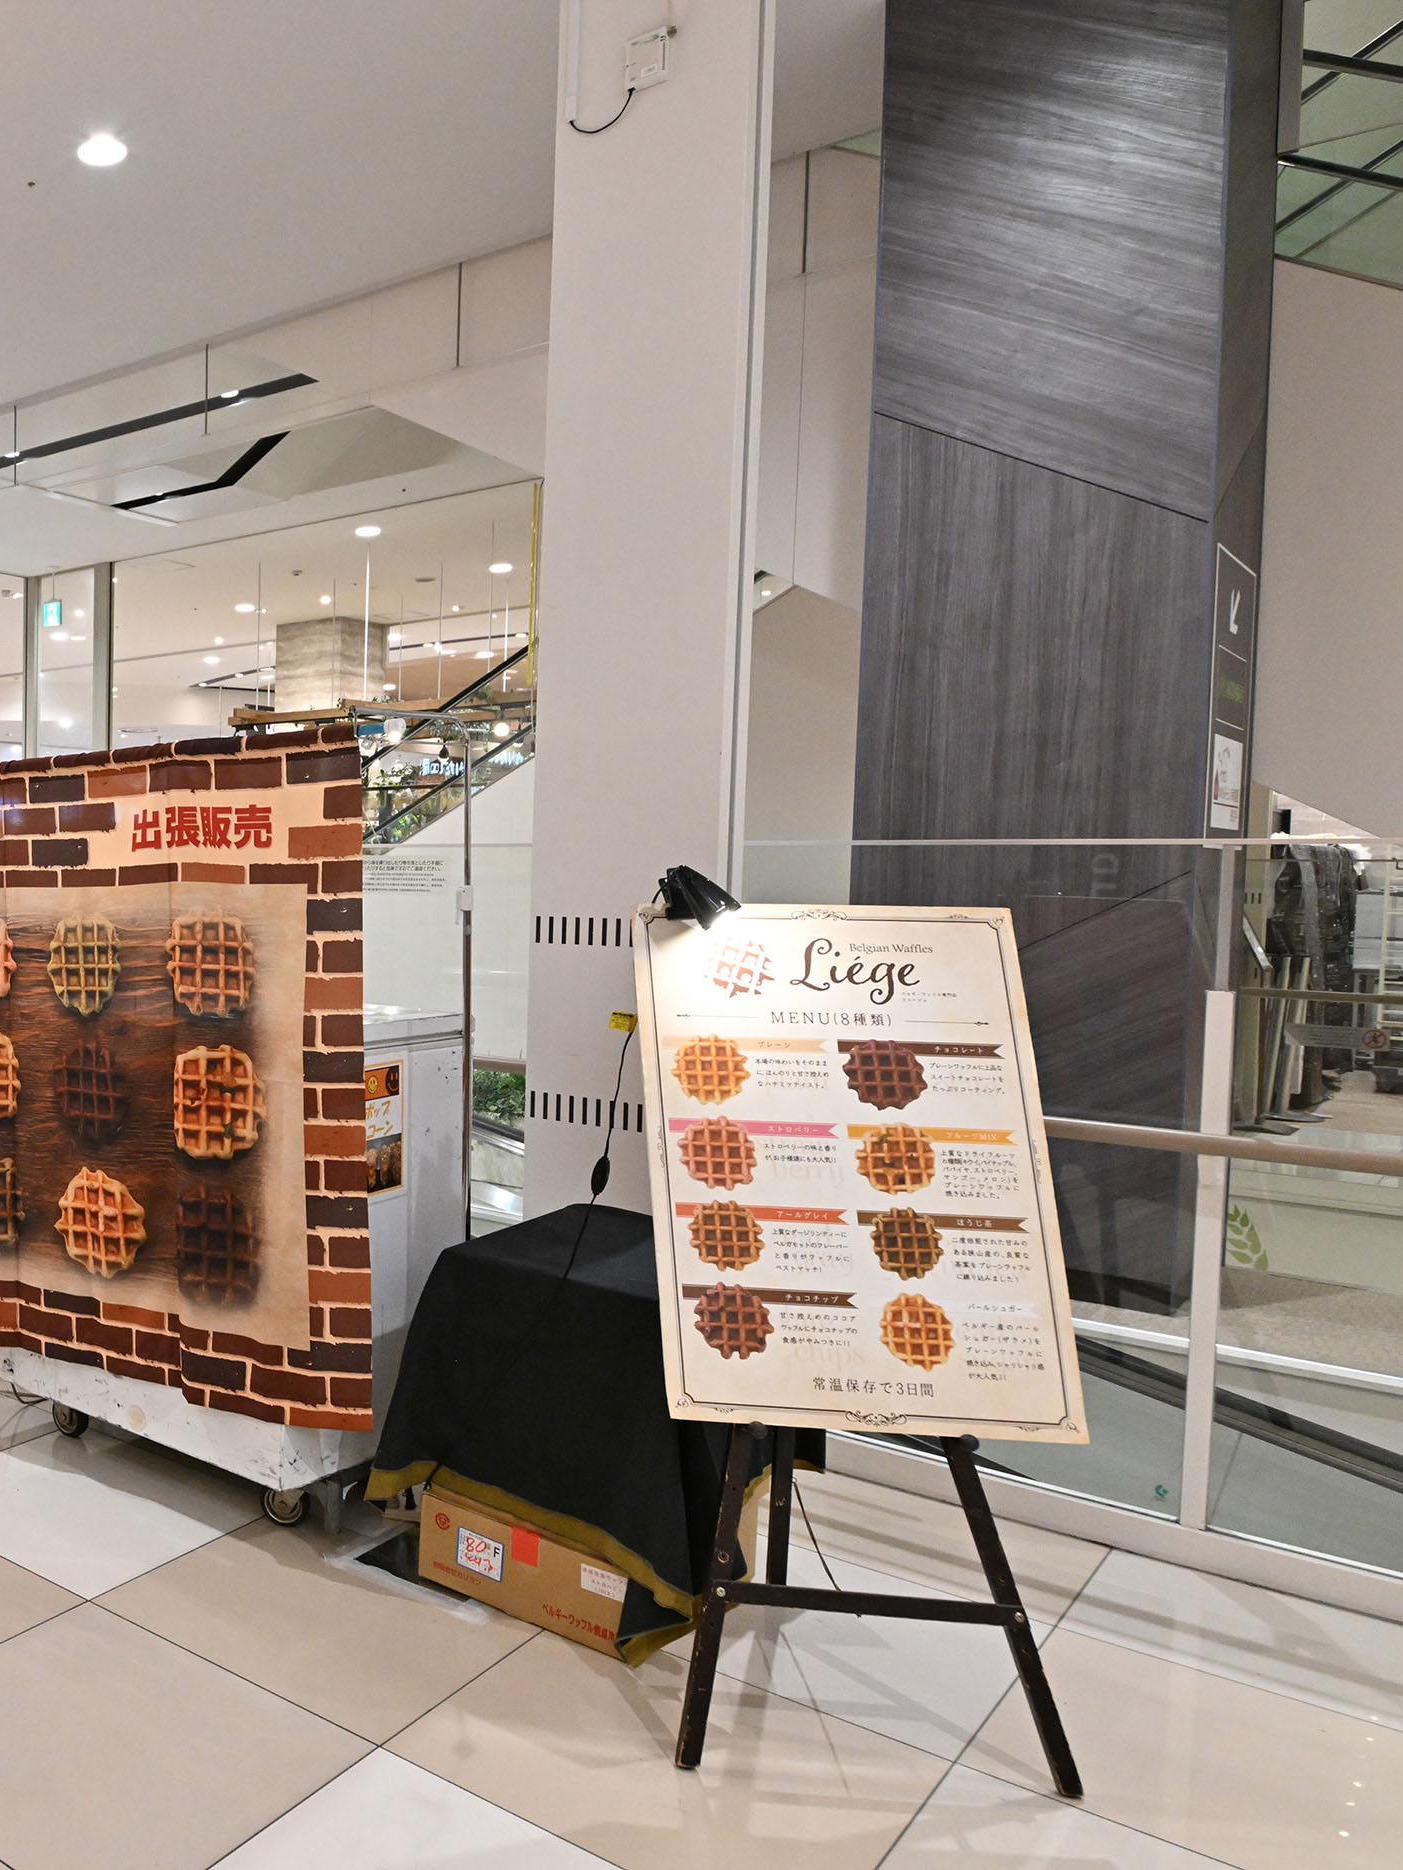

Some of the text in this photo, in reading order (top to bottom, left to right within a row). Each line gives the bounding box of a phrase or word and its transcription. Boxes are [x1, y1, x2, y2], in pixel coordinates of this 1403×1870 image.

[132, 804, 272, 852] 出張販売
[850, 943, 933, 954] Belgian Waffles
[790, 938, 920, 1005] Liége
[934, 1046, 984, 1054] チョコレート
[755, 1058, 828, 1067] 本場の味わいをそのまま
[367, 1121, 393, 1138] コーン
[768, 1125, 818, 1133] ストロベリー
[764, 1143, 837, 1153] ストロベリーの味と香り
[777, 1210, 829, 1220] アールグレイ
[956, 1219, 993, 1228] ほうじ茶
[774, 1252, 849, 1262] と香りがワッフルに
[785, 1294, 839, 1303] チョコチップ
[780, 1312, 856, 1321] 甘さ控えめのココア
[781, 1324, 858, 1334] ワッフルにチョコチップの
[813, 1377, 934, 1397] 常温保存で3日間
